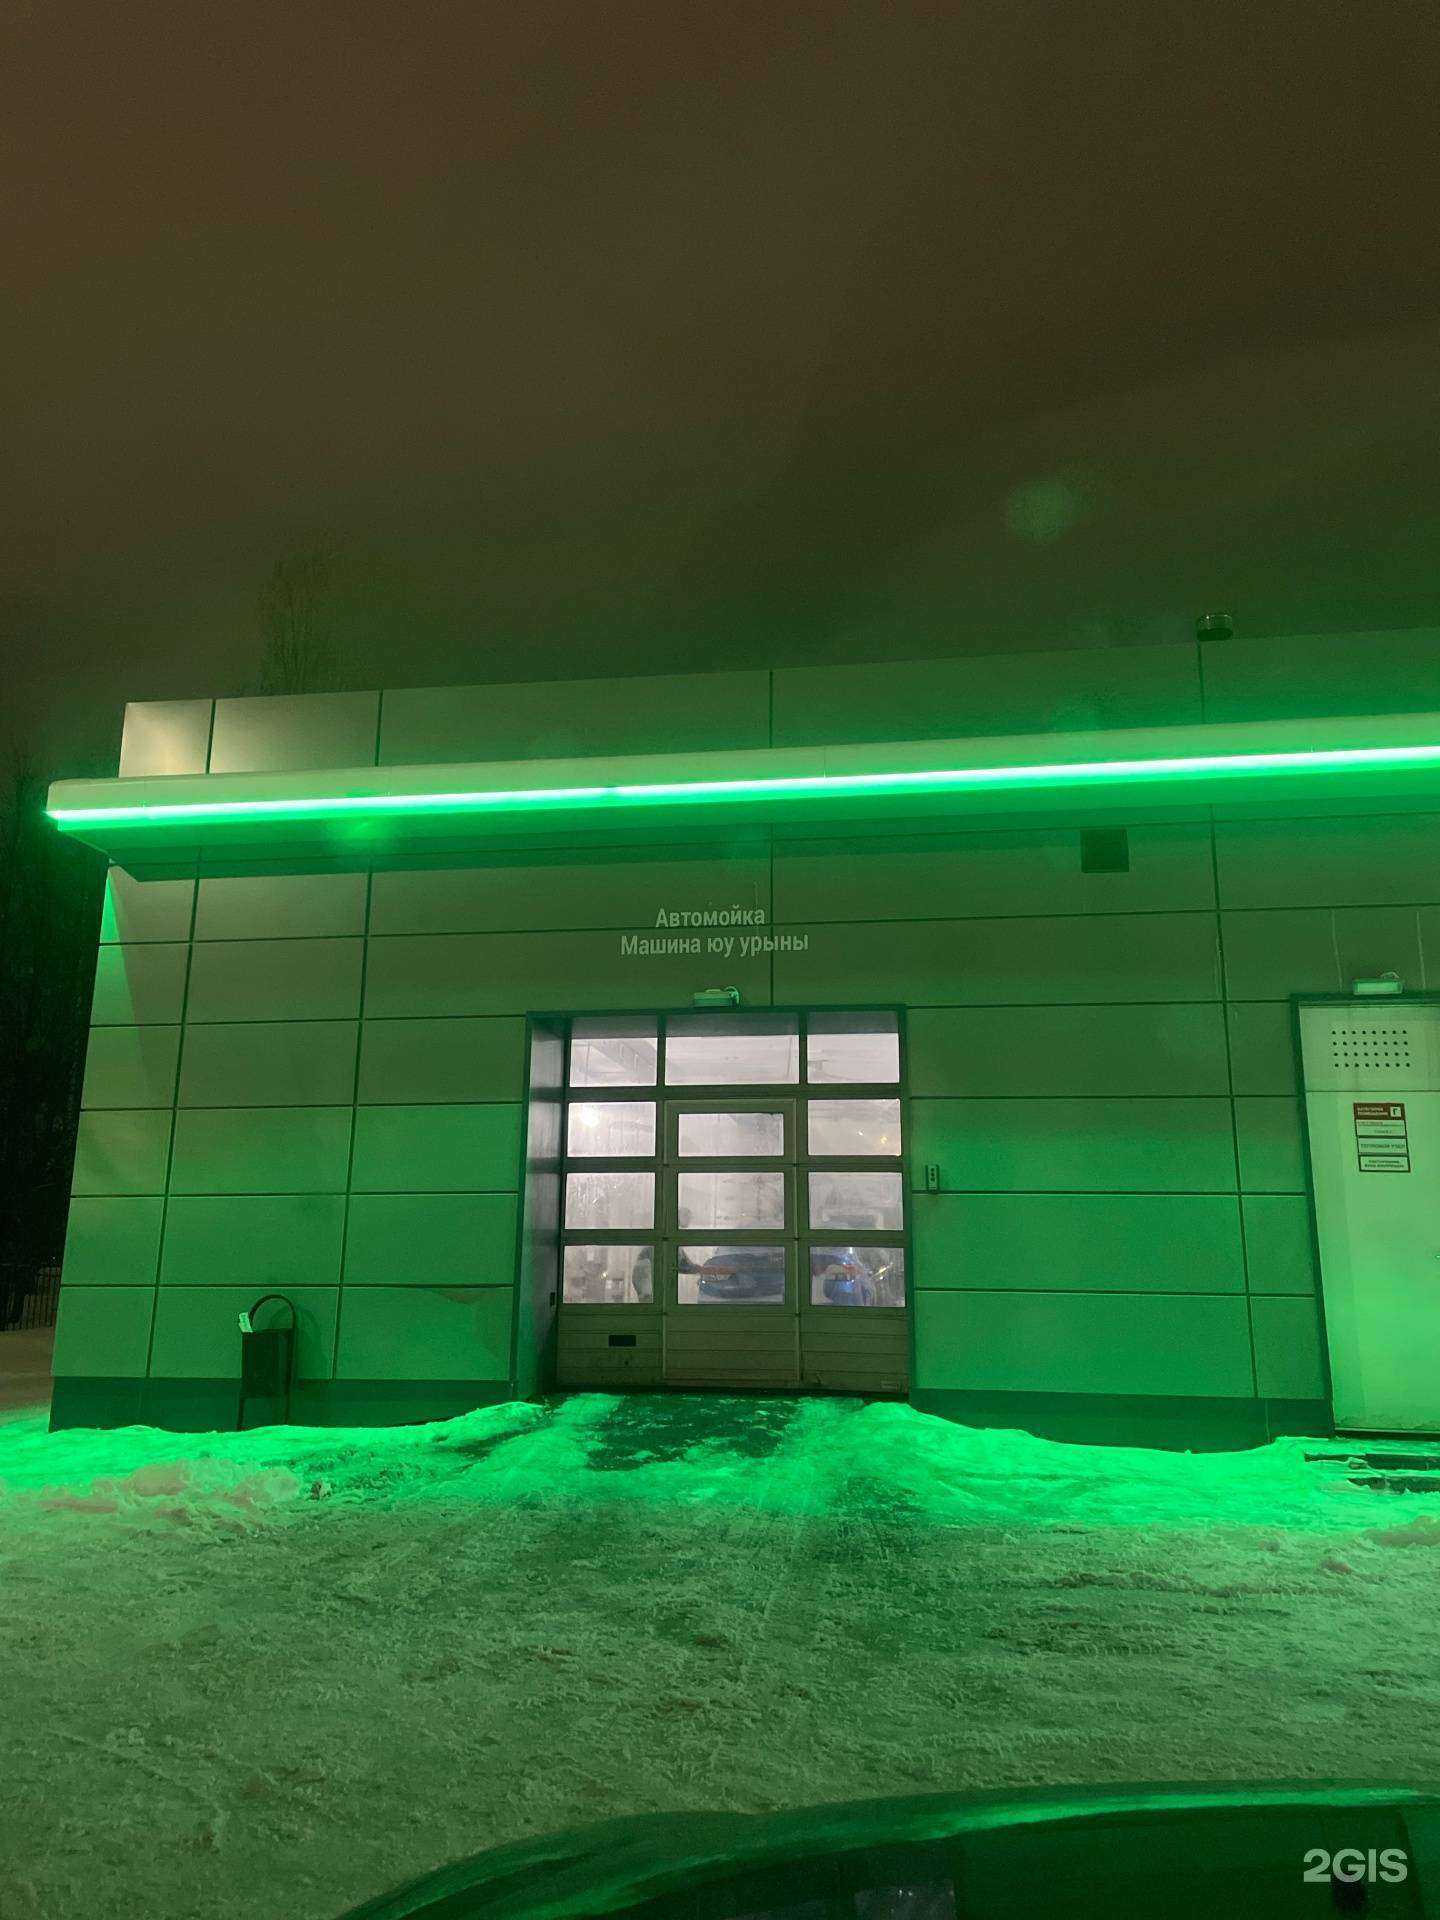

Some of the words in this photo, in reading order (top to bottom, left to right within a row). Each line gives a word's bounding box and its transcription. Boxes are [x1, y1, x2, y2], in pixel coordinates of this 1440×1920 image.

[655, 904, 765, 928] Автомойка
[620, 935, 701, 956] Машина
[707, 936, 734, 958] юу
[740, 934, 809, 957] урыны
